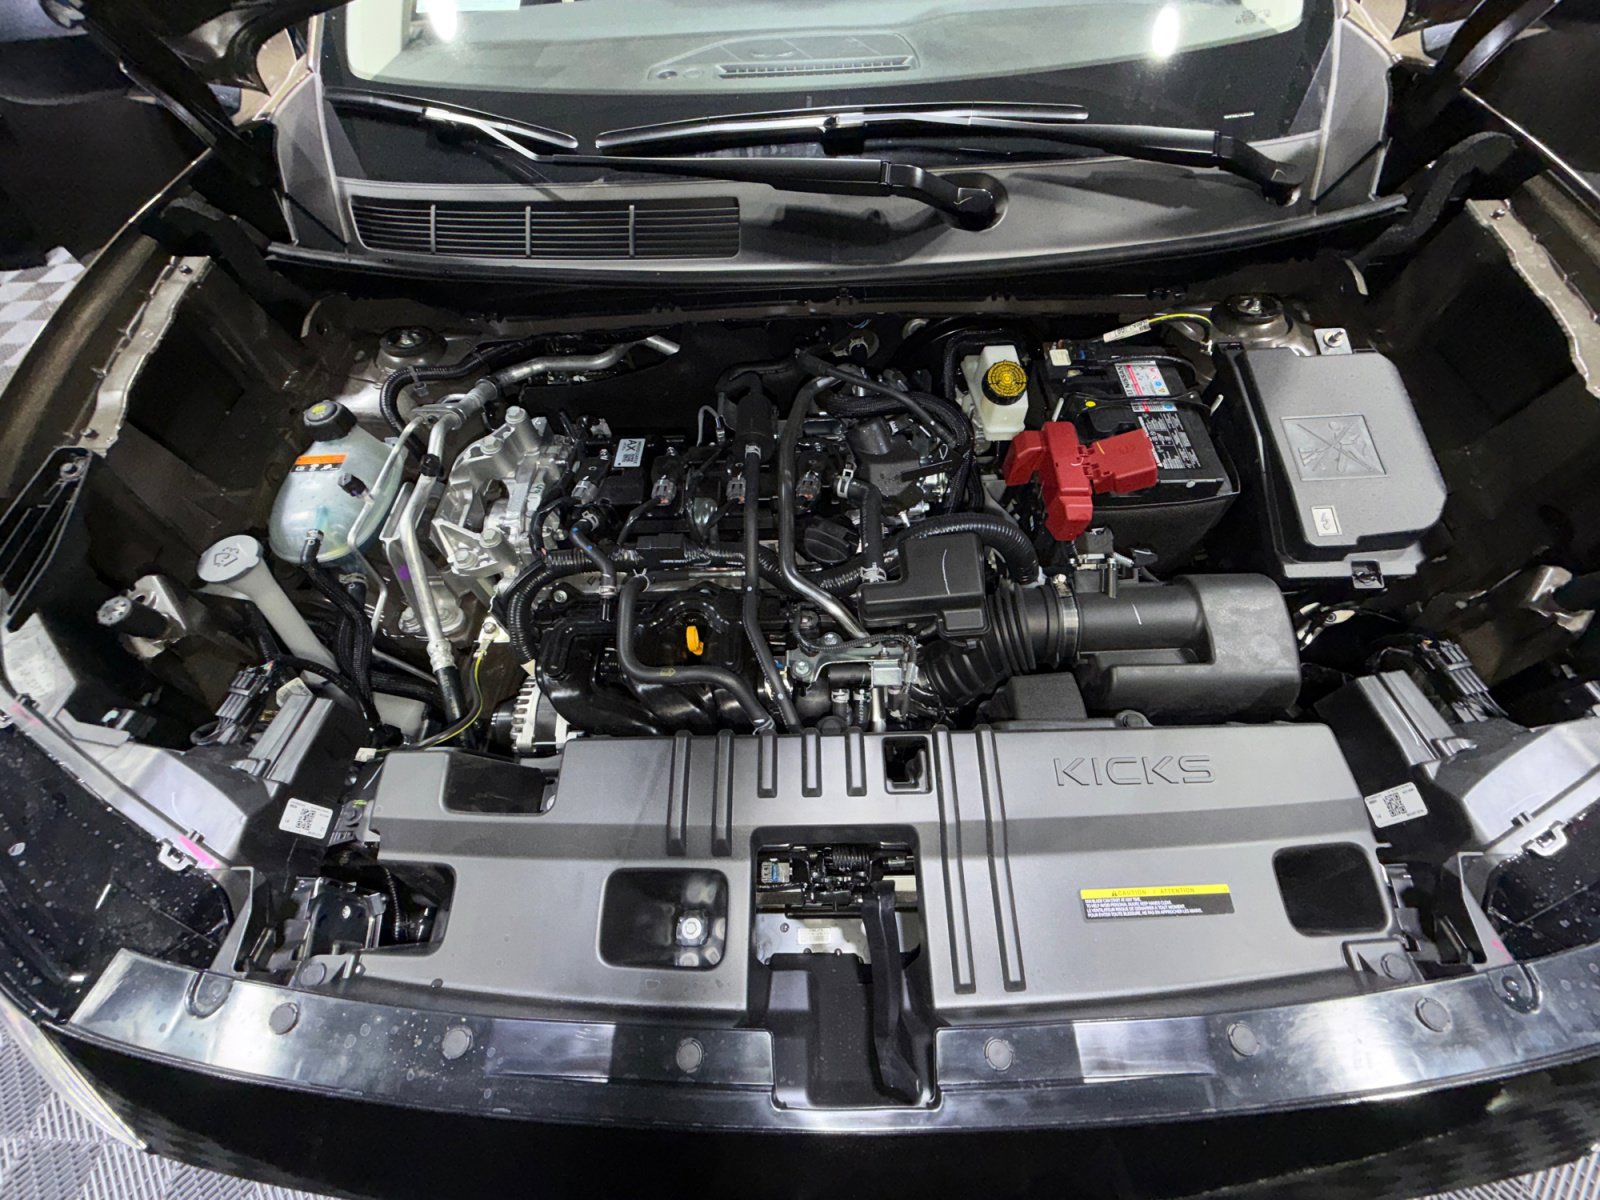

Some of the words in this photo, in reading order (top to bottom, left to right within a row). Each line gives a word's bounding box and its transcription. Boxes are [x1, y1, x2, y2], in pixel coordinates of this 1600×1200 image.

[1116, 364, 1131, 389] NISSAN
[626, 439, 638, 451] AX
[1053, 755, 1216, 787] KICKS
